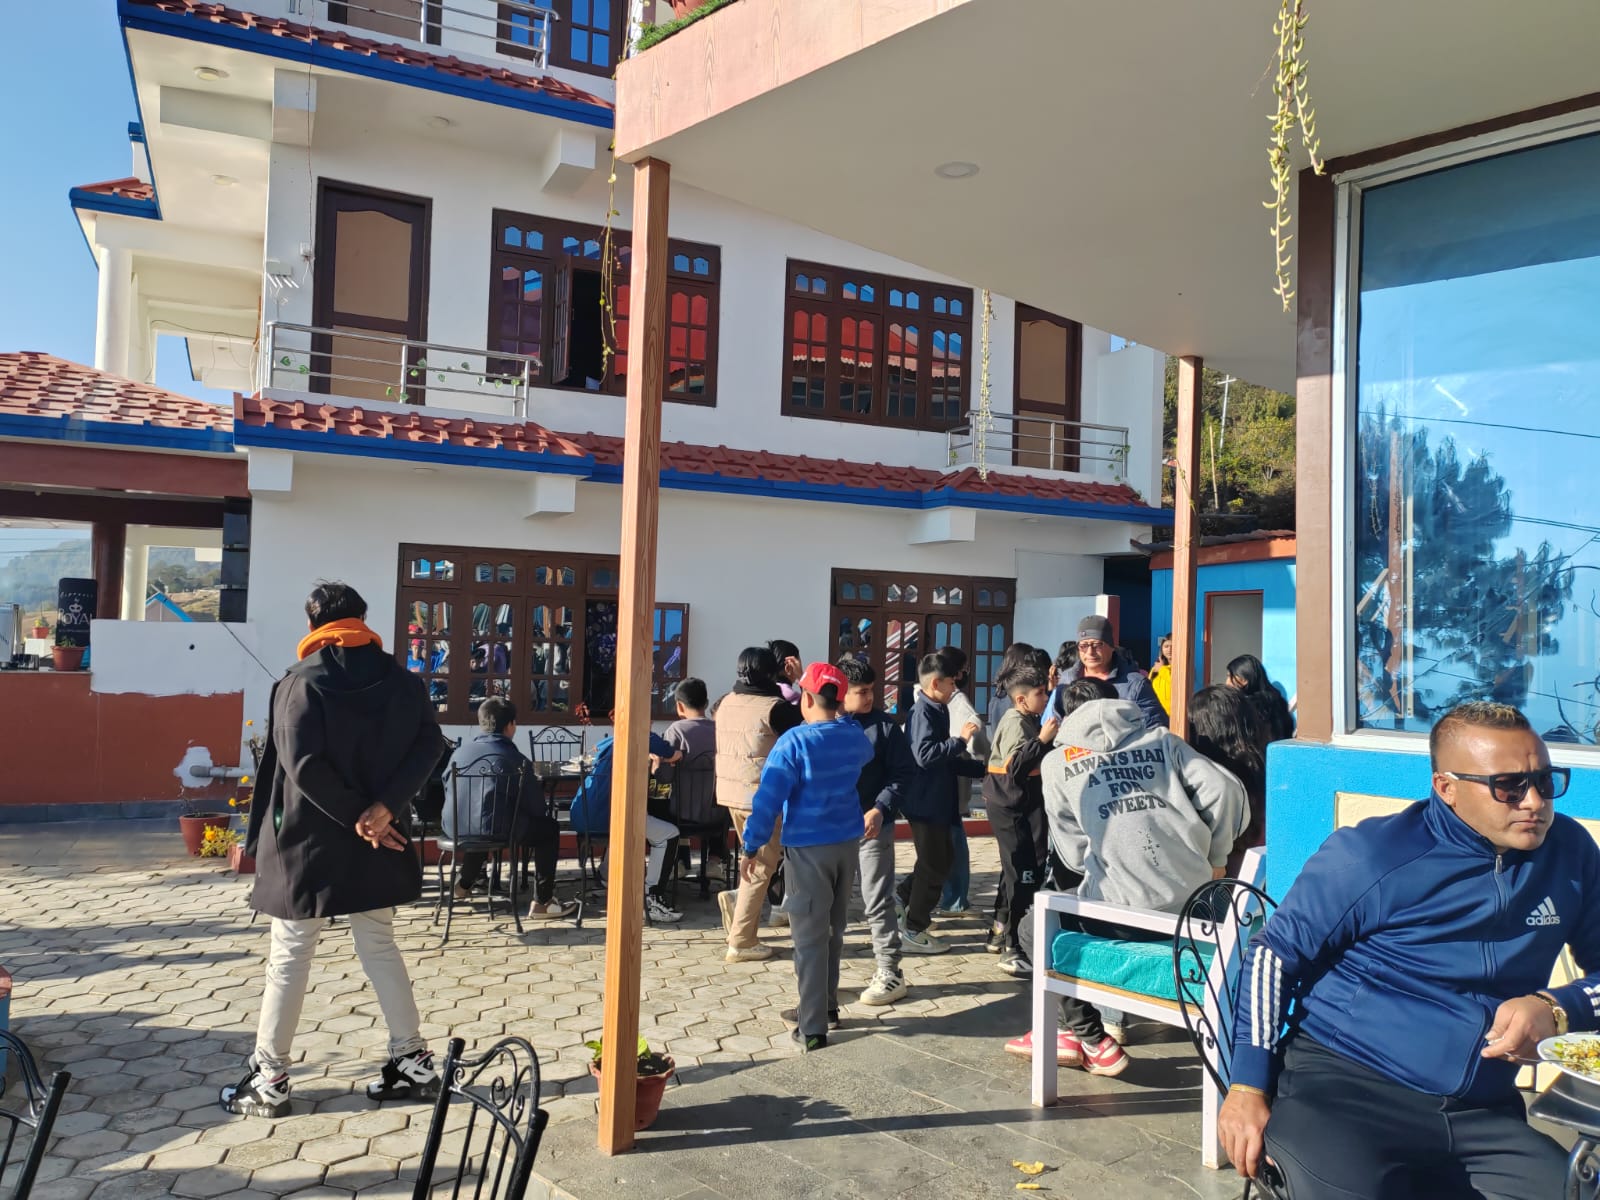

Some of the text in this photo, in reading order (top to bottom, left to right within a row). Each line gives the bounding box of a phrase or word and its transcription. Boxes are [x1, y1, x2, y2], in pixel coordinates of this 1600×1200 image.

[1064, 752, 1128, 782] ALWAYS
[1130, 748, 1165, 764] HAD
[1088, 765, 1155, 788] A THING
[1108, 781, 1145, 797] FOR
[1525, 915, 1560, 926] adidas
